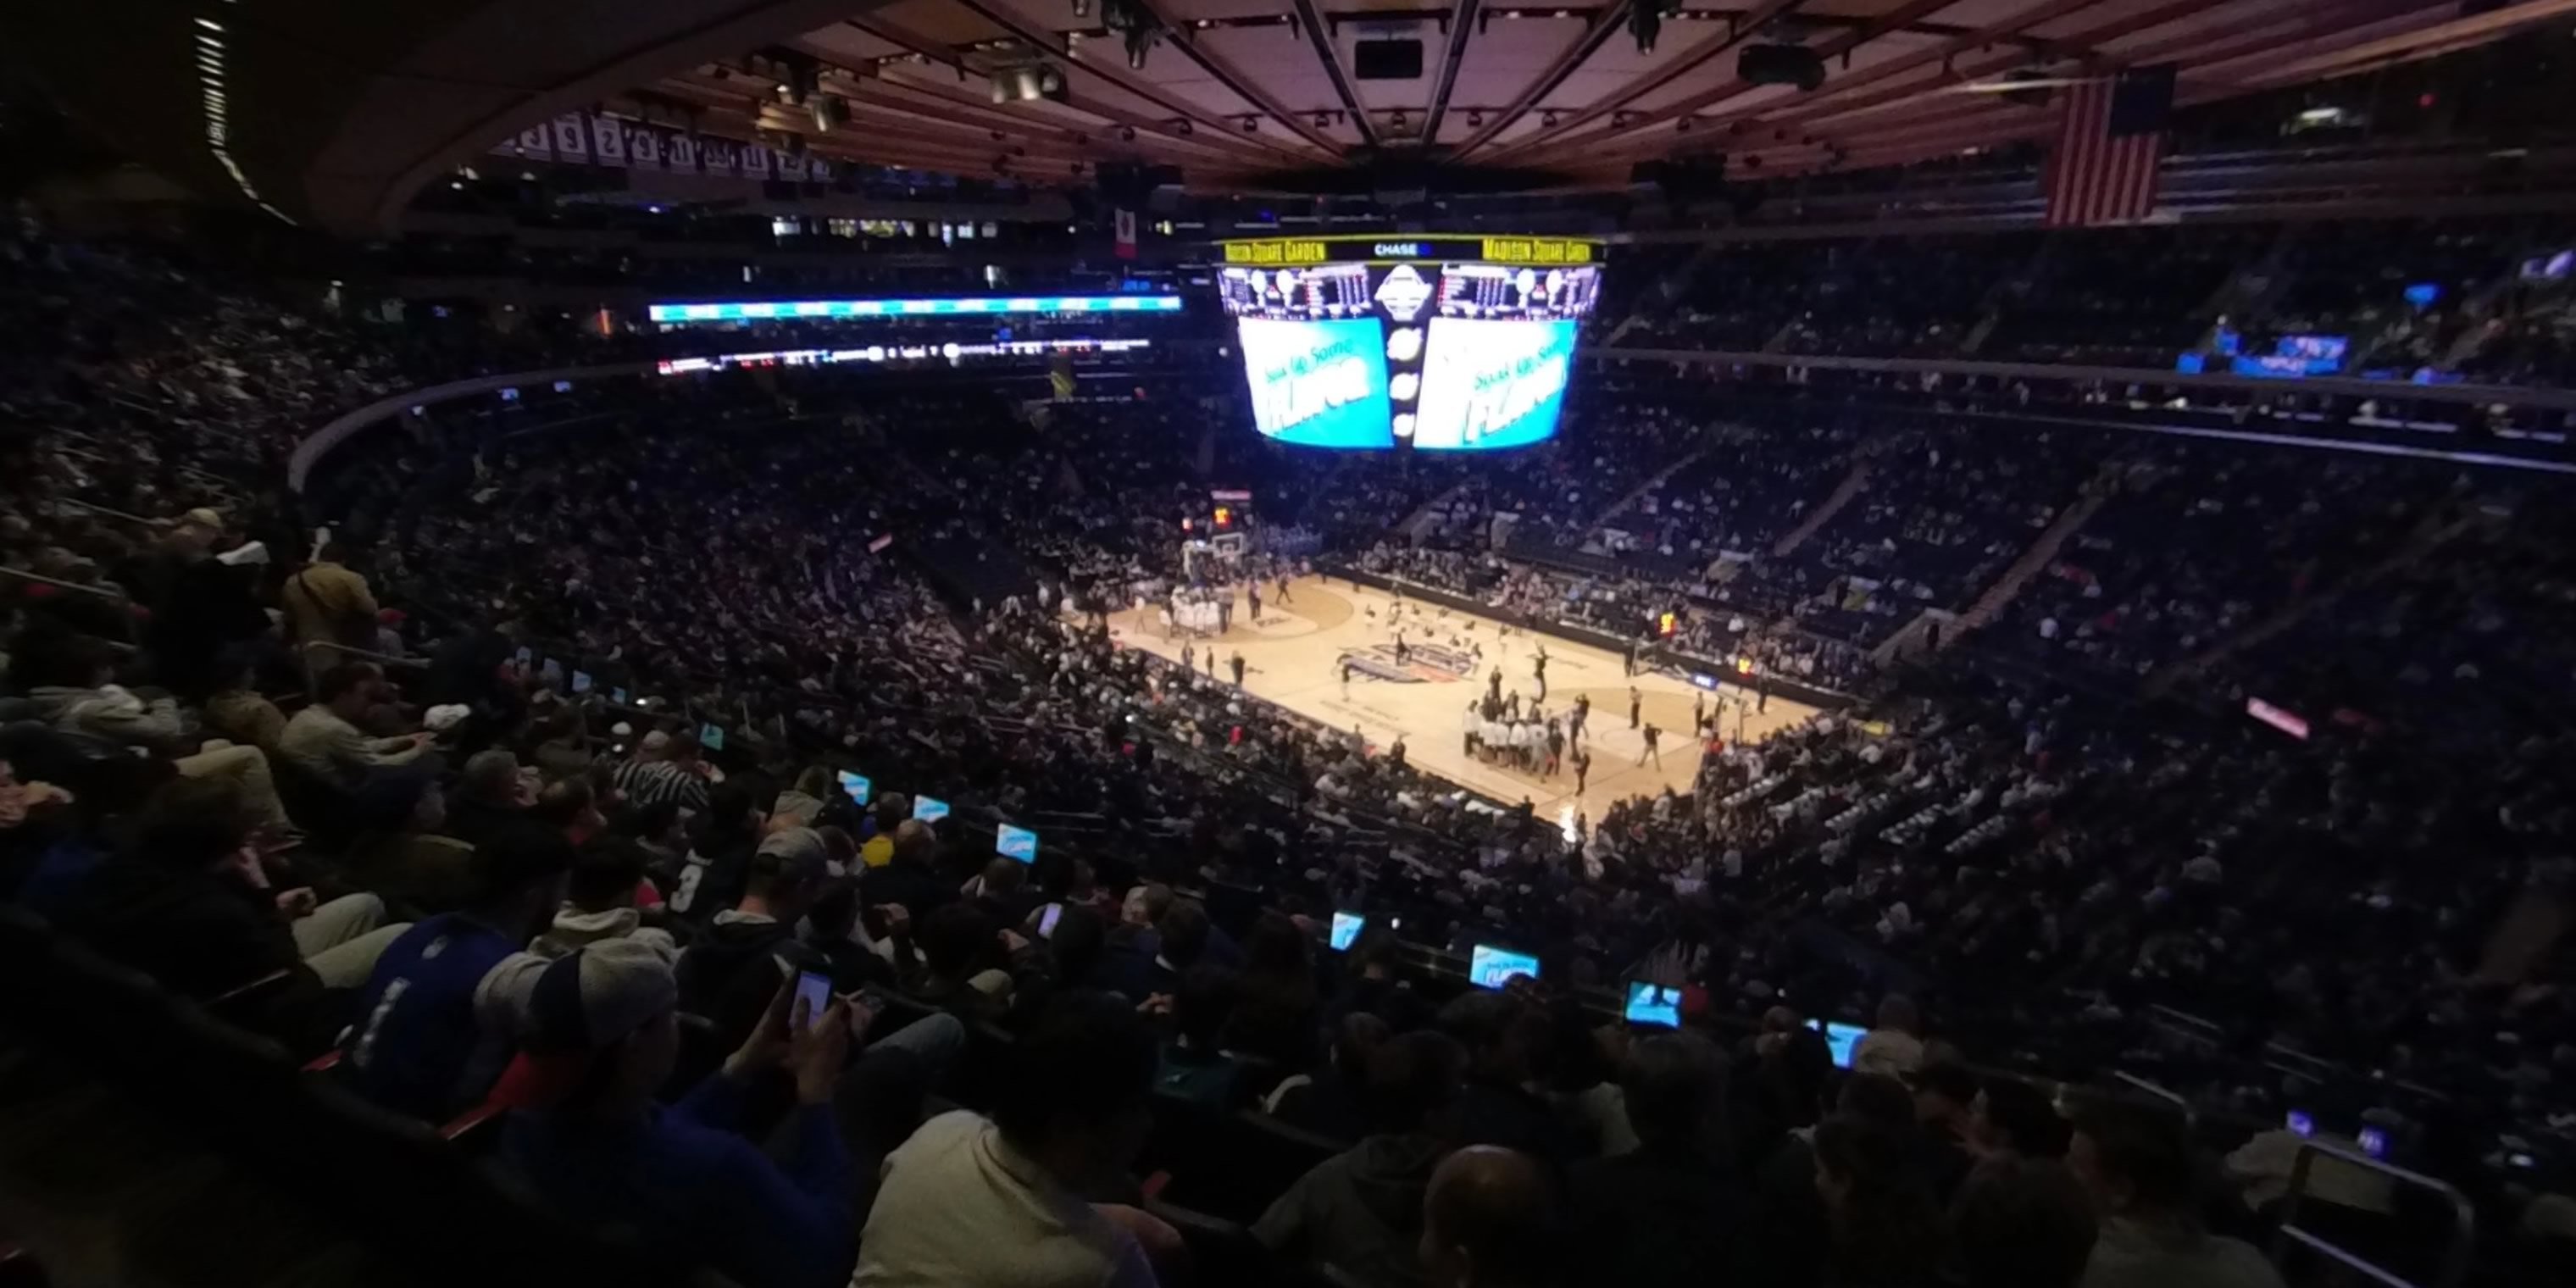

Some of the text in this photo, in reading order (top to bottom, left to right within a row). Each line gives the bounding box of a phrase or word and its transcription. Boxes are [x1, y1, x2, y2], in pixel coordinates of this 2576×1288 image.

[1285, 241, 1324, 261] GARDEN
[1374, 242, 1418, 257] CHASE
[1483, 238, 1530, 260] MADISON
